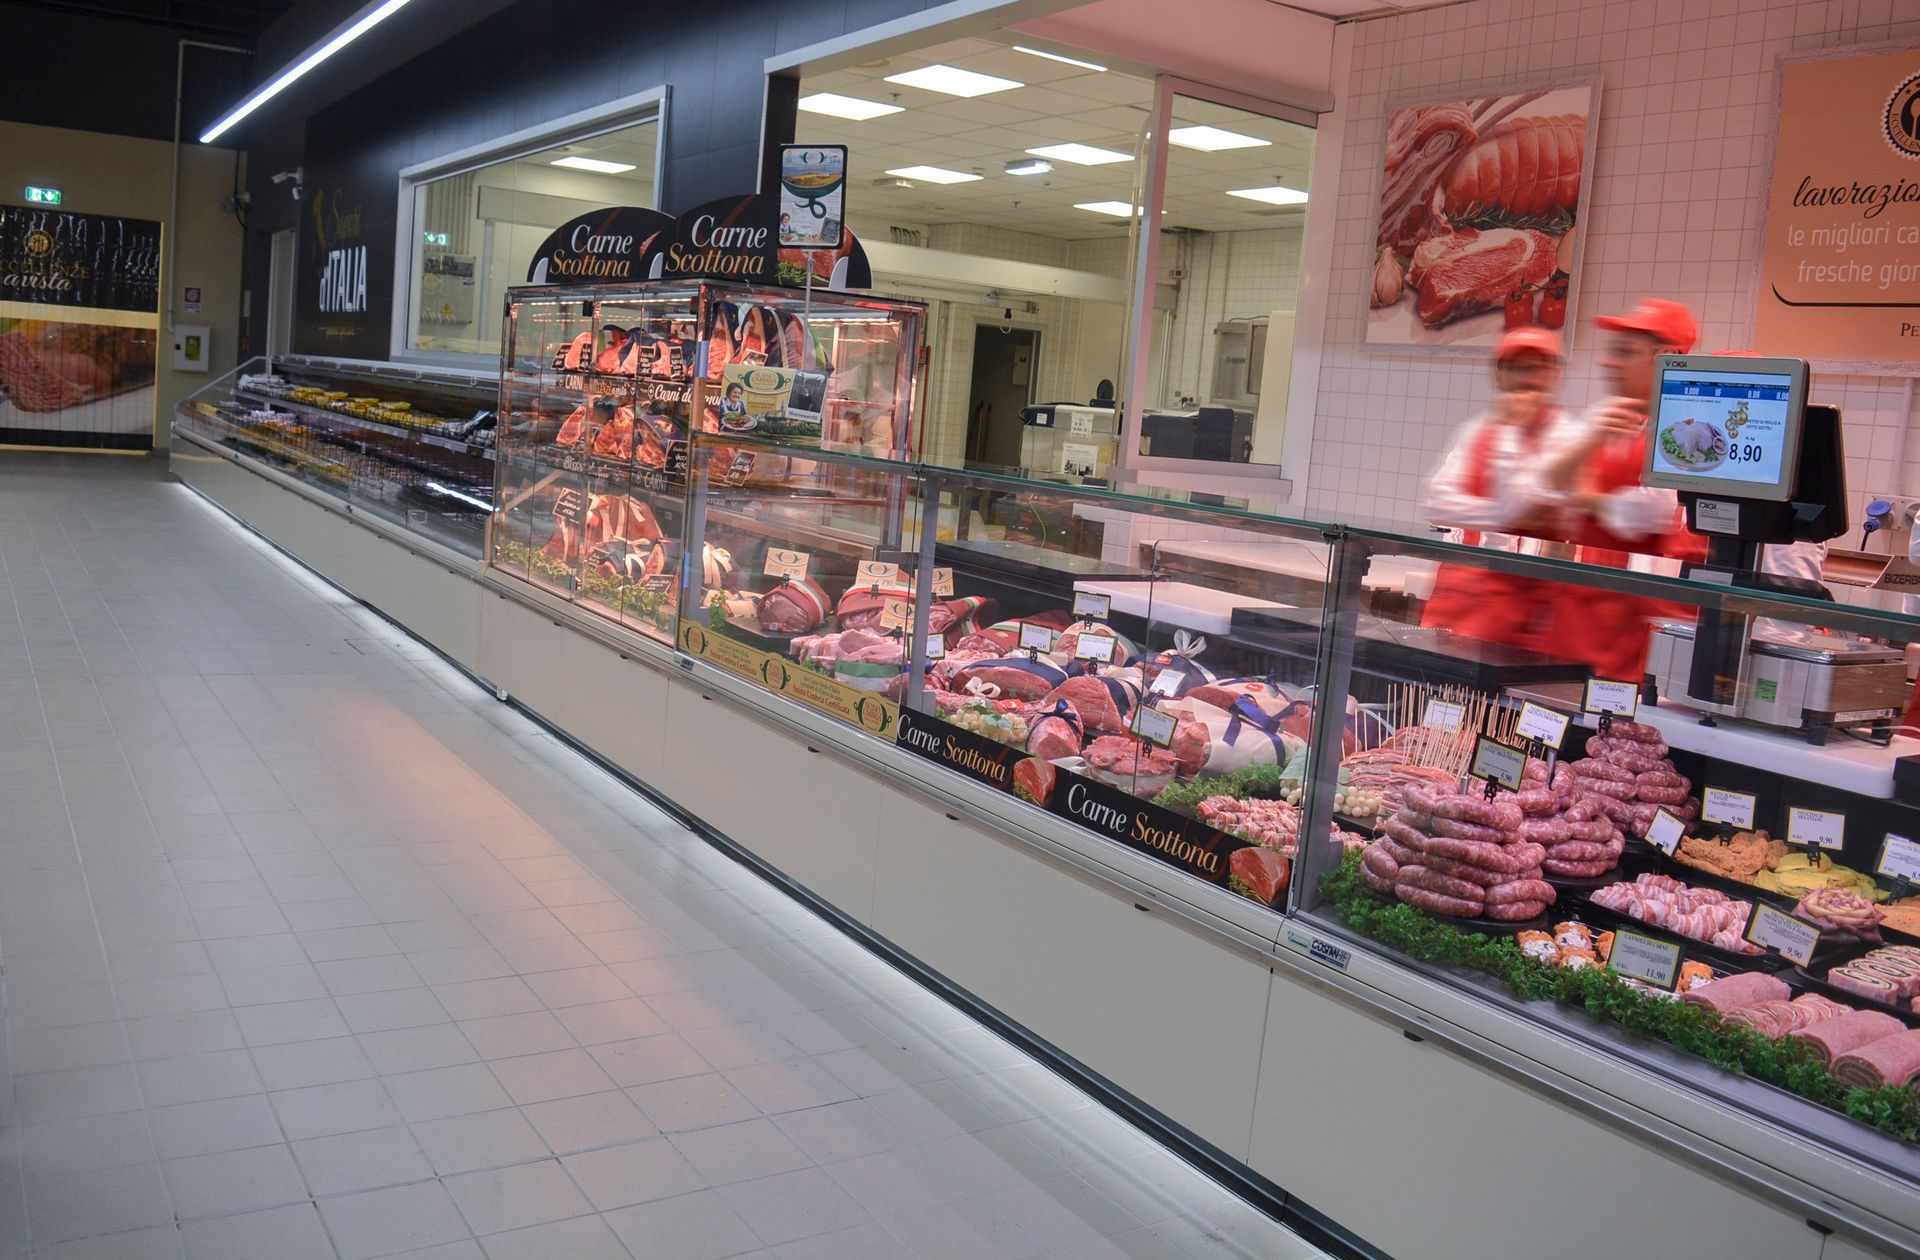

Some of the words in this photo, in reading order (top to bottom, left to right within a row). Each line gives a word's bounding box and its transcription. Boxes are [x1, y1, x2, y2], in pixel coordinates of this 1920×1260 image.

[571, 224, 633, 254] Carne
[691, 214, 768, 248] Carne
[1788, 224, 1805, 246] le
[1811, 221, 1891, 253] migliori
[549, 249, 631, 277] Scottona
[665, 242, 766, 275] Scottona
[1798, 259, 1873, 283] fresche
[565, 373, 584, 391] CARNI
[655, 384, 680, 402] Carni
[1729, 443, 1762, 464] 8,90
[897, 714, 940, 754] Carne
[943, 734, 1006, 783] Scottona
[1068, 783, 1128, 833] Carne
[1130, 811, 1220, 873] Scottona
[1731, 815, 1745, 824] 9,90
[1819, 835, 1833, 844] 9,90
[1787, 946, 1803, 959] 9,90
[1645, 968, 1666, 980] 11,90
